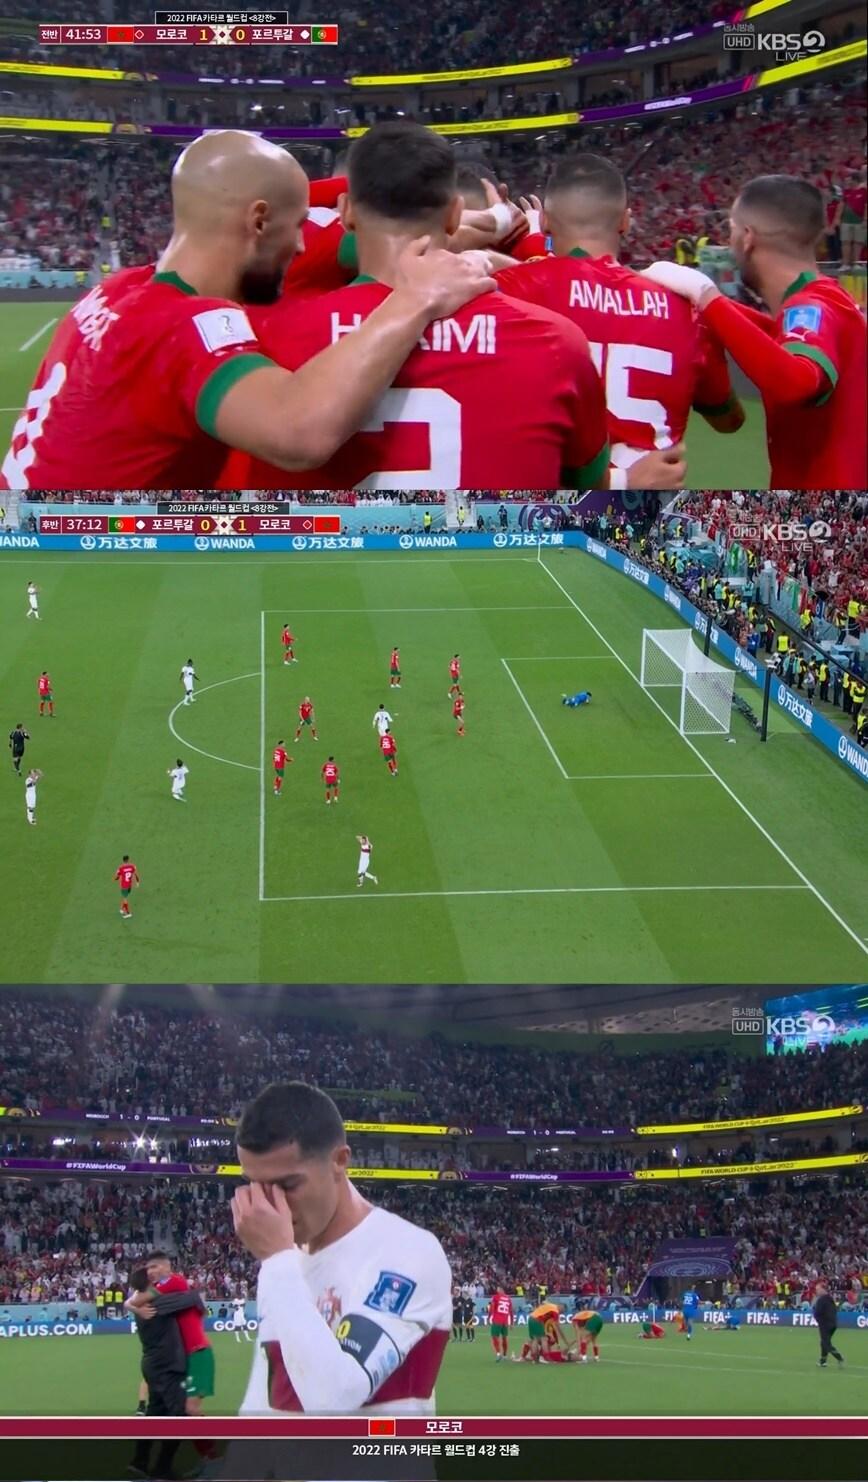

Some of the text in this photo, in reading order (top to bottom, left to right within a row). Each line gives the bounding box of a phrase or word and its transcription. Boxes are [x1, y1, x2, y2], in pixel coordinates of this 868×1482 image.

[569, 280, 669, 319] AMALLAH
[98, 537, 158, 549] 万达文旅
[210, 538, 255, 549] WANDA
[308, 537, 364, 550] 万达文旅
[415, 535, 457, 547] WANDA
[509, 534, 564, 546] 万达文旅
[857, 1315, 868, 1328] G
